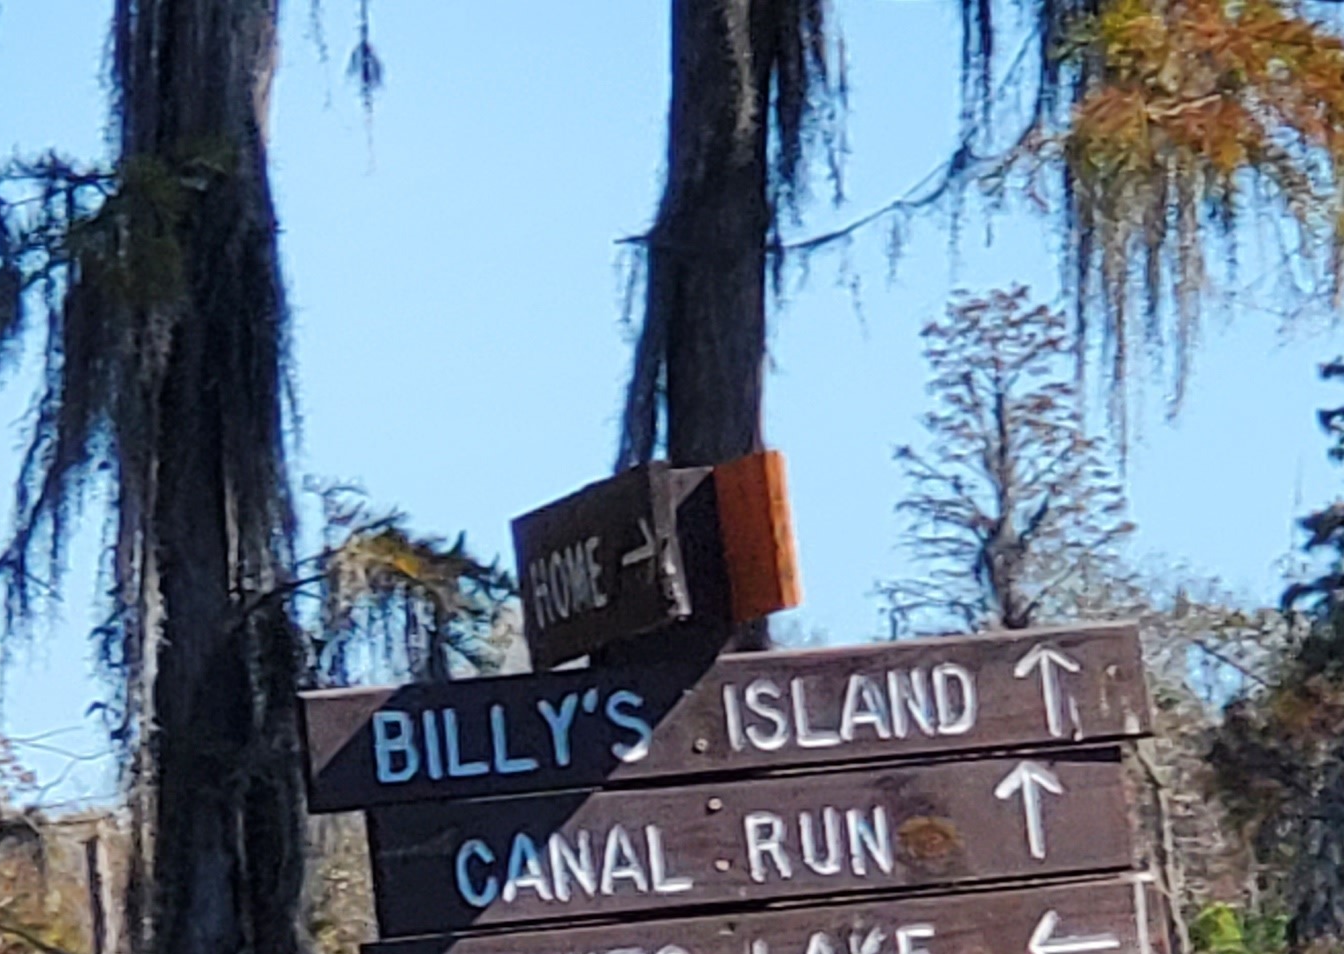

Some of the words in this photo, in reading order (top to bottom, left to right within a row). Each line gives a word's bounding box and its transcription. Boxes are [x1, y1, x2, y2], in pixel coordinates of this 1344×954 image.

[528, 535, 608, 630] HOME
[372, 687, 654, 784] BILLY'S
[722, 661, 978, 752] ISLAND
[456, 823, 695, 908] CANAL
[743, 805, 894, 882] RUN
